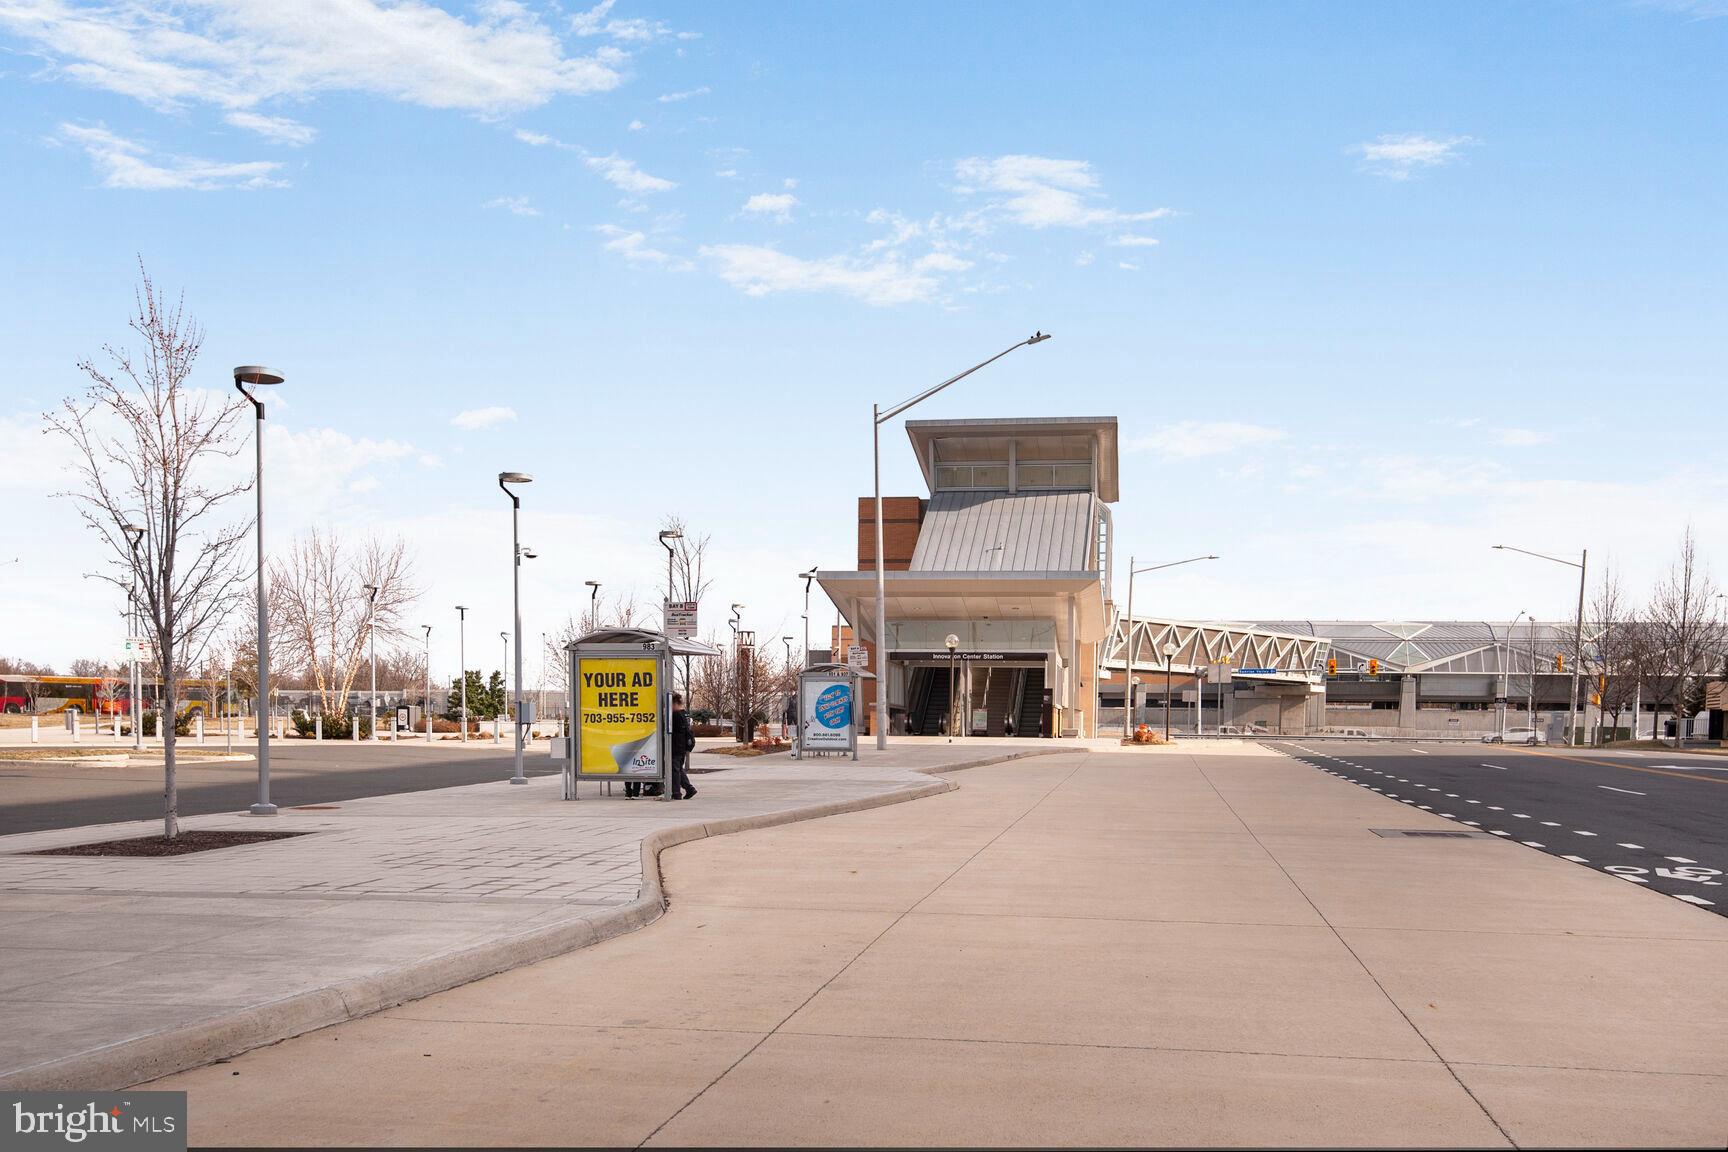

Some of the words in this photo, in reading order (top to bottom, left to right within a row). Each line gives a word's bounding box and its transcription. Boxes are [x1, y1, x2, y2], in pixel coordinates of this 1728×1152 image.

[742, 632, 754, 646] M
[584, 672, 626, 688] YOUR
[632, 672, 653, 688] AD
[598, 692, 639, 708] HERE
[584, 712, 656, 723] 703-955-7952
